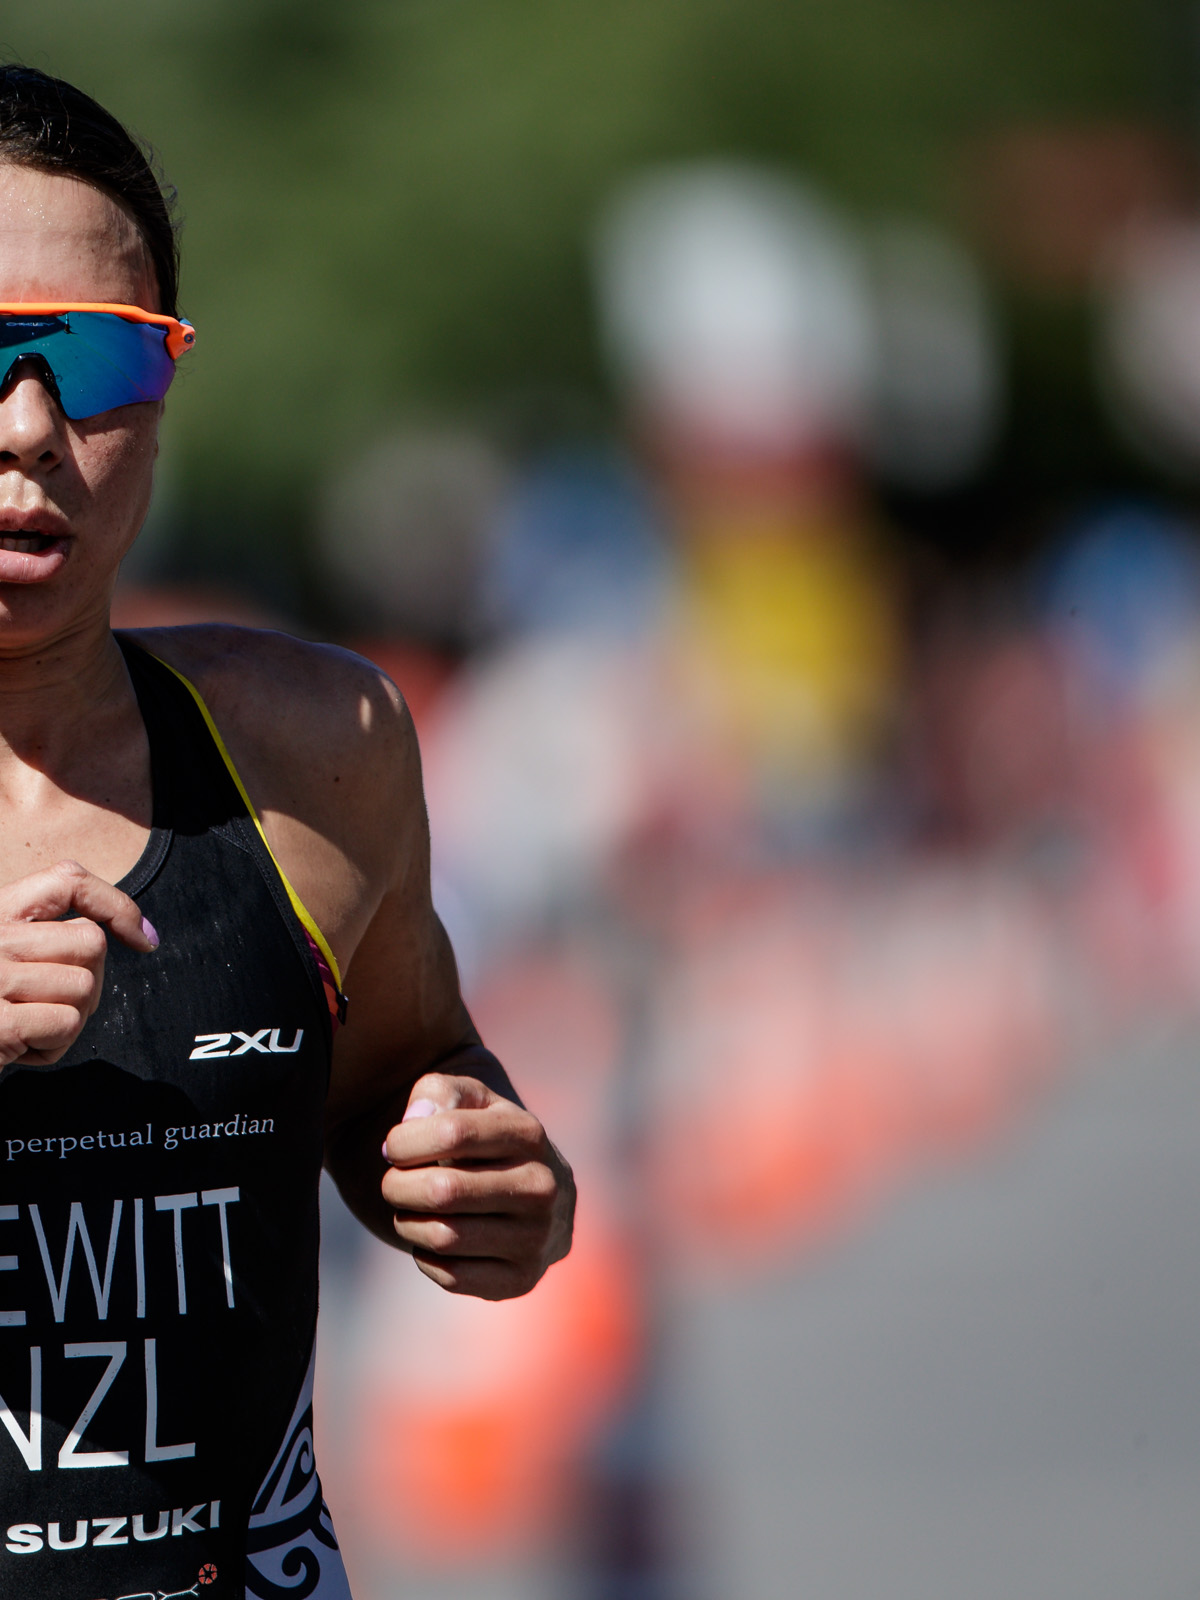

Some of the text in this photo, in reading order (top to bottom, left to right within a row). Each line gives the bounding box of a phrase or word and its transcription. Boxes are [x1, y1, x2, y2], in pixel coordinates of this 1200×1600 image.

[188, 1028, 303, 1060] 2XU
[5, 1113, 275, 1161] perpetual guardian
[5, 1500, 221, 1554] SUZUKI
